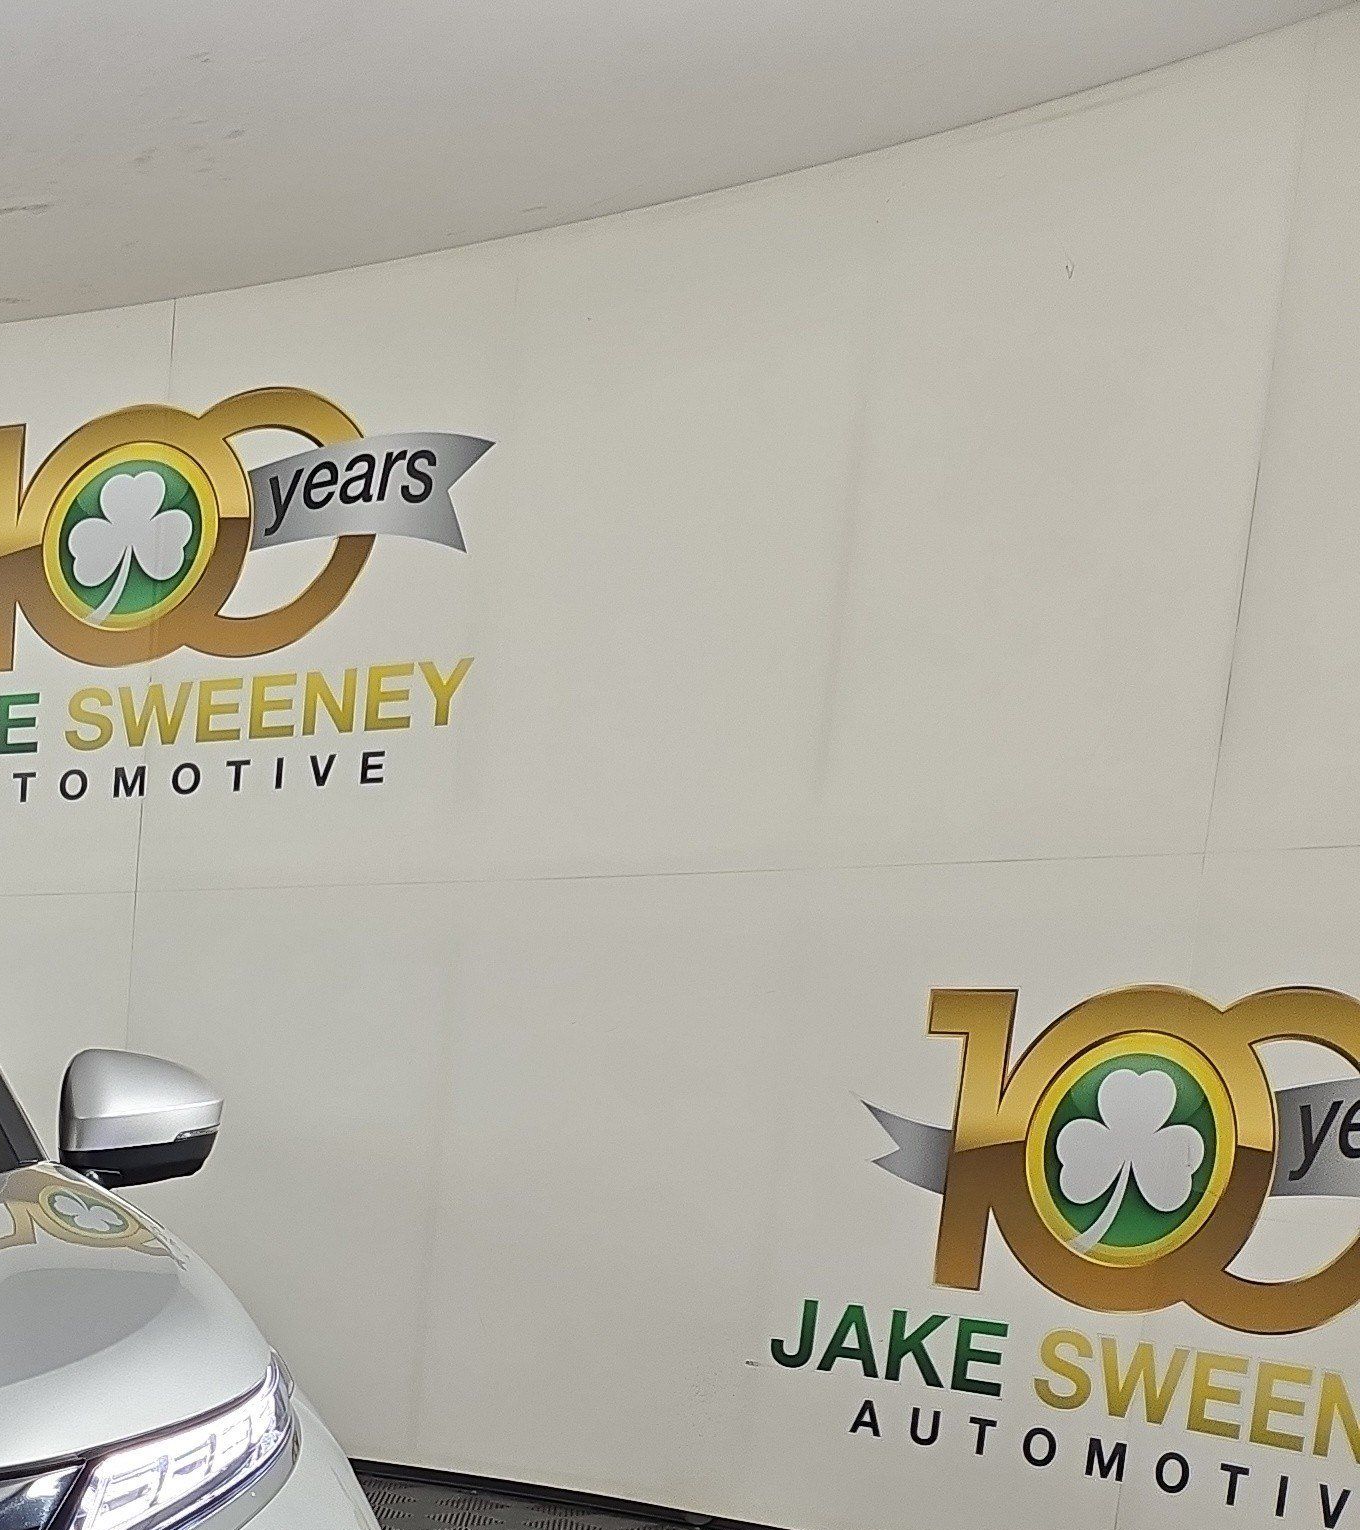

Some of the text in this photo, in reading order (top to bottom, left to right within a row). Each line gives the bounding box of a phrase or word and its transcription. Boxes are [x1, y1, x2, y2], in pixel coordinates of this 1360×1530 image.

[264, 448, 438, 535] years
[64, 656, 475, 751] SWEENEY
[770, 1299, 1360, 1466] JAKE SWEEN
[849, 1400, 1351, 1529] AUTOMOTIV
